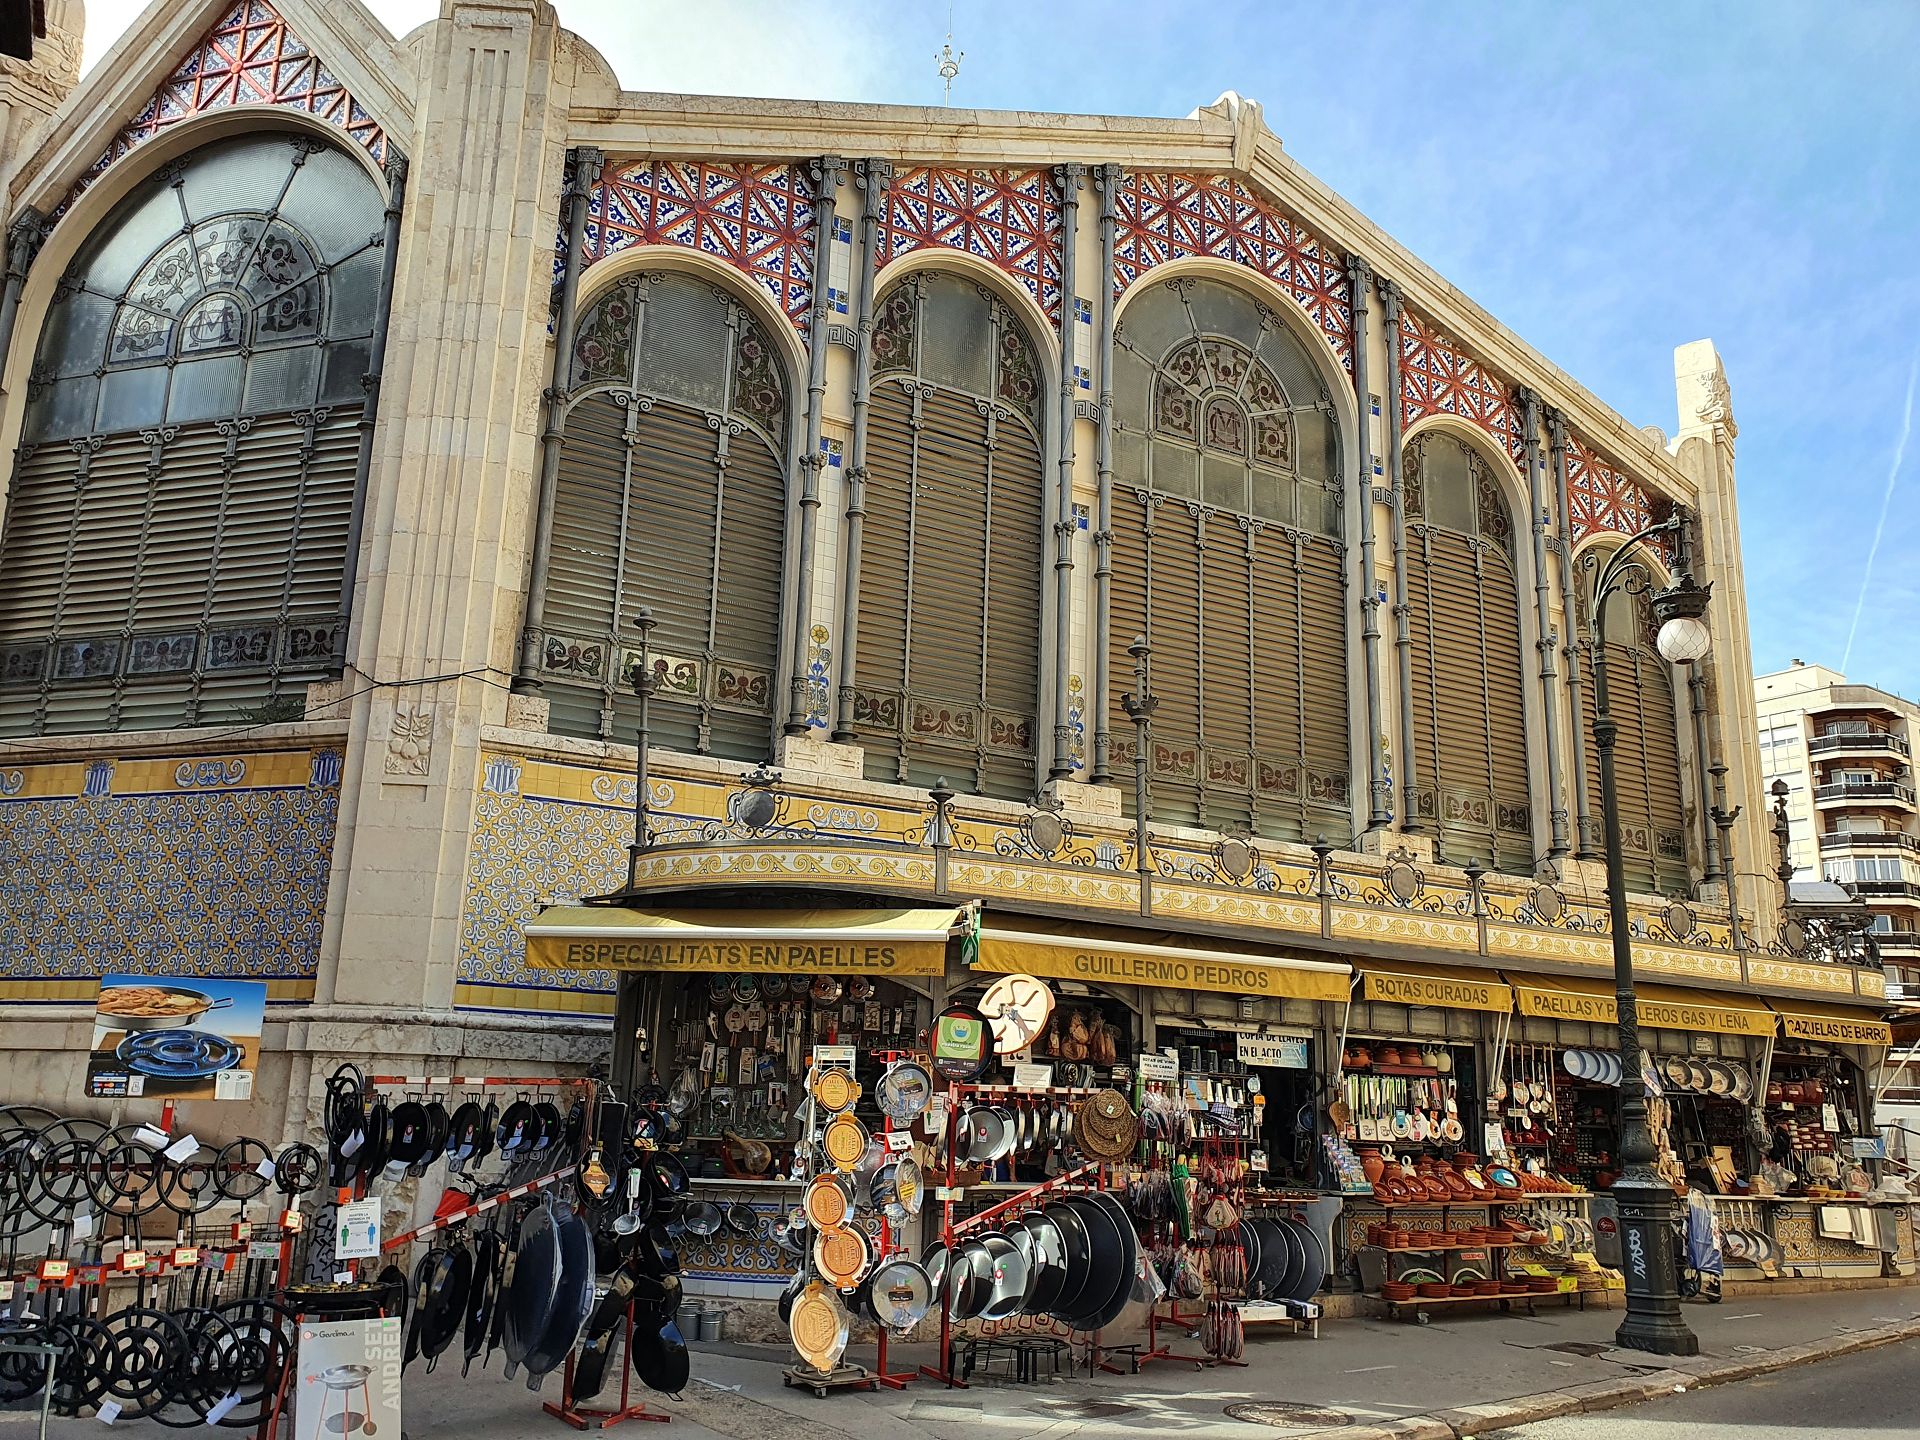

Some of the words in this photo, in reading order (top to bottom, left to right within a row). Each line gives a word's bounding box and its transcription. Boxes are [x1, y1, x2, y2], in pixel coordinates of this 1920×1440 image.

[566, 943, 742, 965] ESPECIALITATS
[750, 945, 781, 966] EN
[787, 946, 896, 968] PAELLES
[1074, 954, 1188, 982] GUILLERMO
[1193, 965, 1269, 989] PEDROS
[1375, 978, 1421, 998] BOTAS
[1425, 983, 1489, 1004] CURADAS
[1533, 995, 1592, 1015] PAELLAS
[1594, 1001, 1604, 1017] Y
[1681, 1010, 1706, 1026] GAS
[1708, 1012, 1718, 1027] Y
[1719, 1012, 1750, 1030] LEÑA
[1841, 1024, 1852, 1038] DE
[1854, 1026, 1887, 1040] BARRO
[1239, 1045, 1249, 1057] EN
[1261, 1047, 1282, 1058] ACTO
